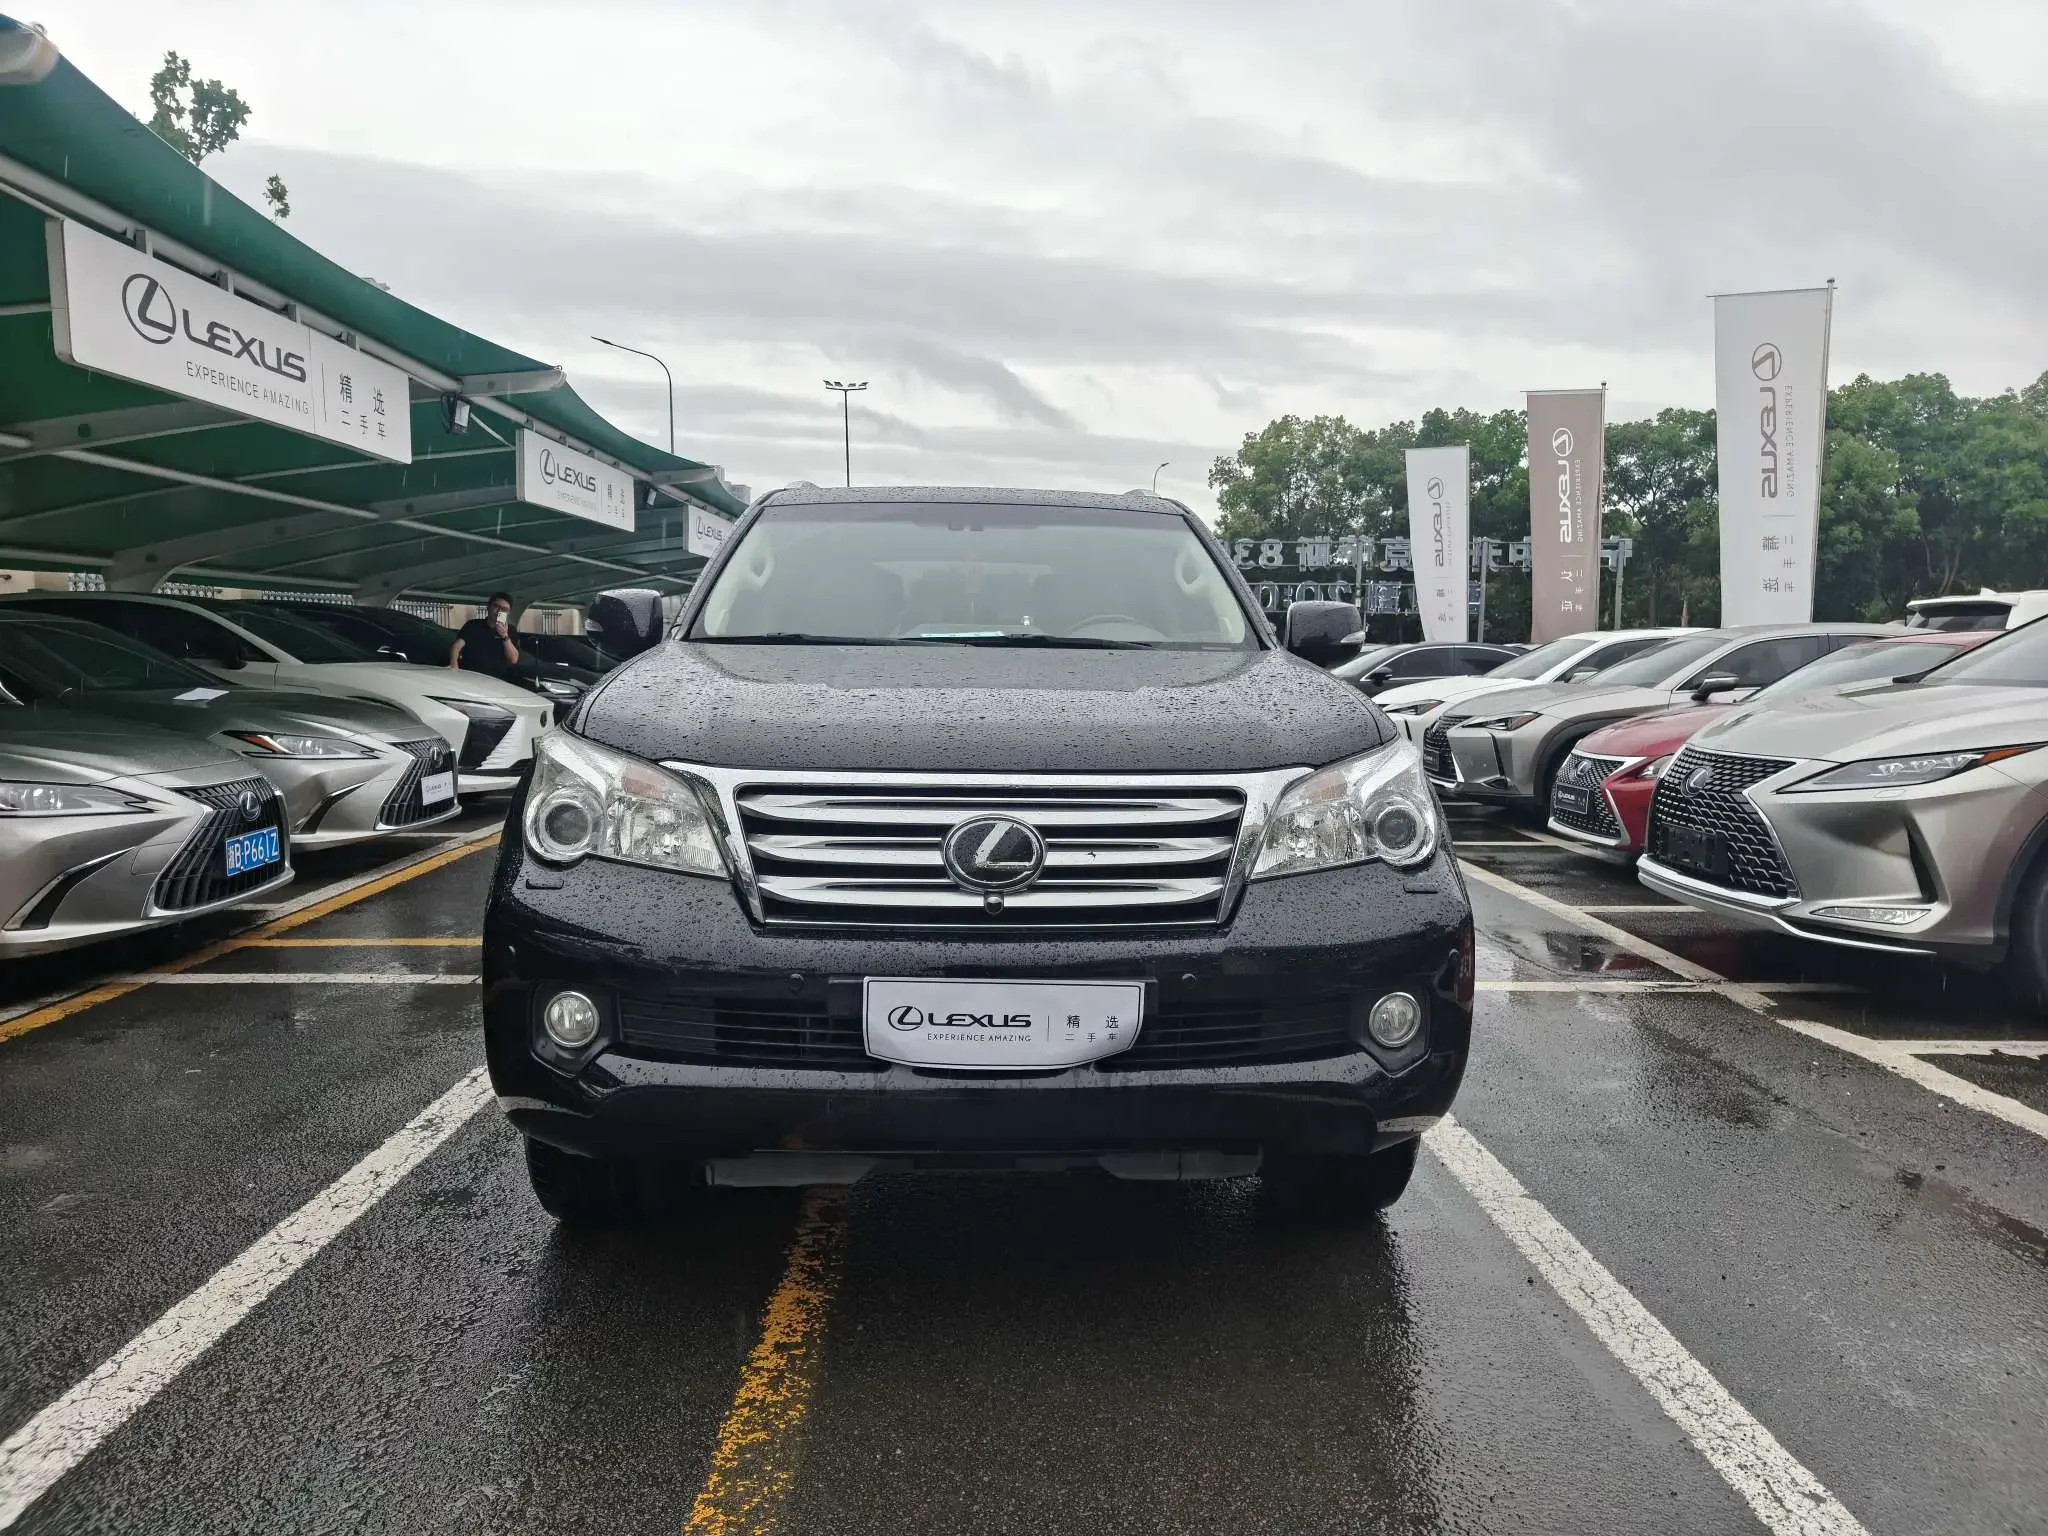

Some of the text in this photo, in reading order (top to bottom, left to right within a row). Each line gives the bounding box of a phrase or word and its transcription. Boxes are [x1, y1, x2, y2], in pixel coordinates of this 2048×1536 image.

[182, 308, 307, 383] LEXUS
[186, 361, 309, 415] EXPERIENCE AMAZING
[338, 373, 386, 416] 精选
[556, 462, 597, 493] LEXUS
[927, 1013, 1032, 1028] LEXUS
[1066, 1014, 1120, 1030] 精选
[927, 1032, 1032, 1043] EXPERIENCE AMAZING
